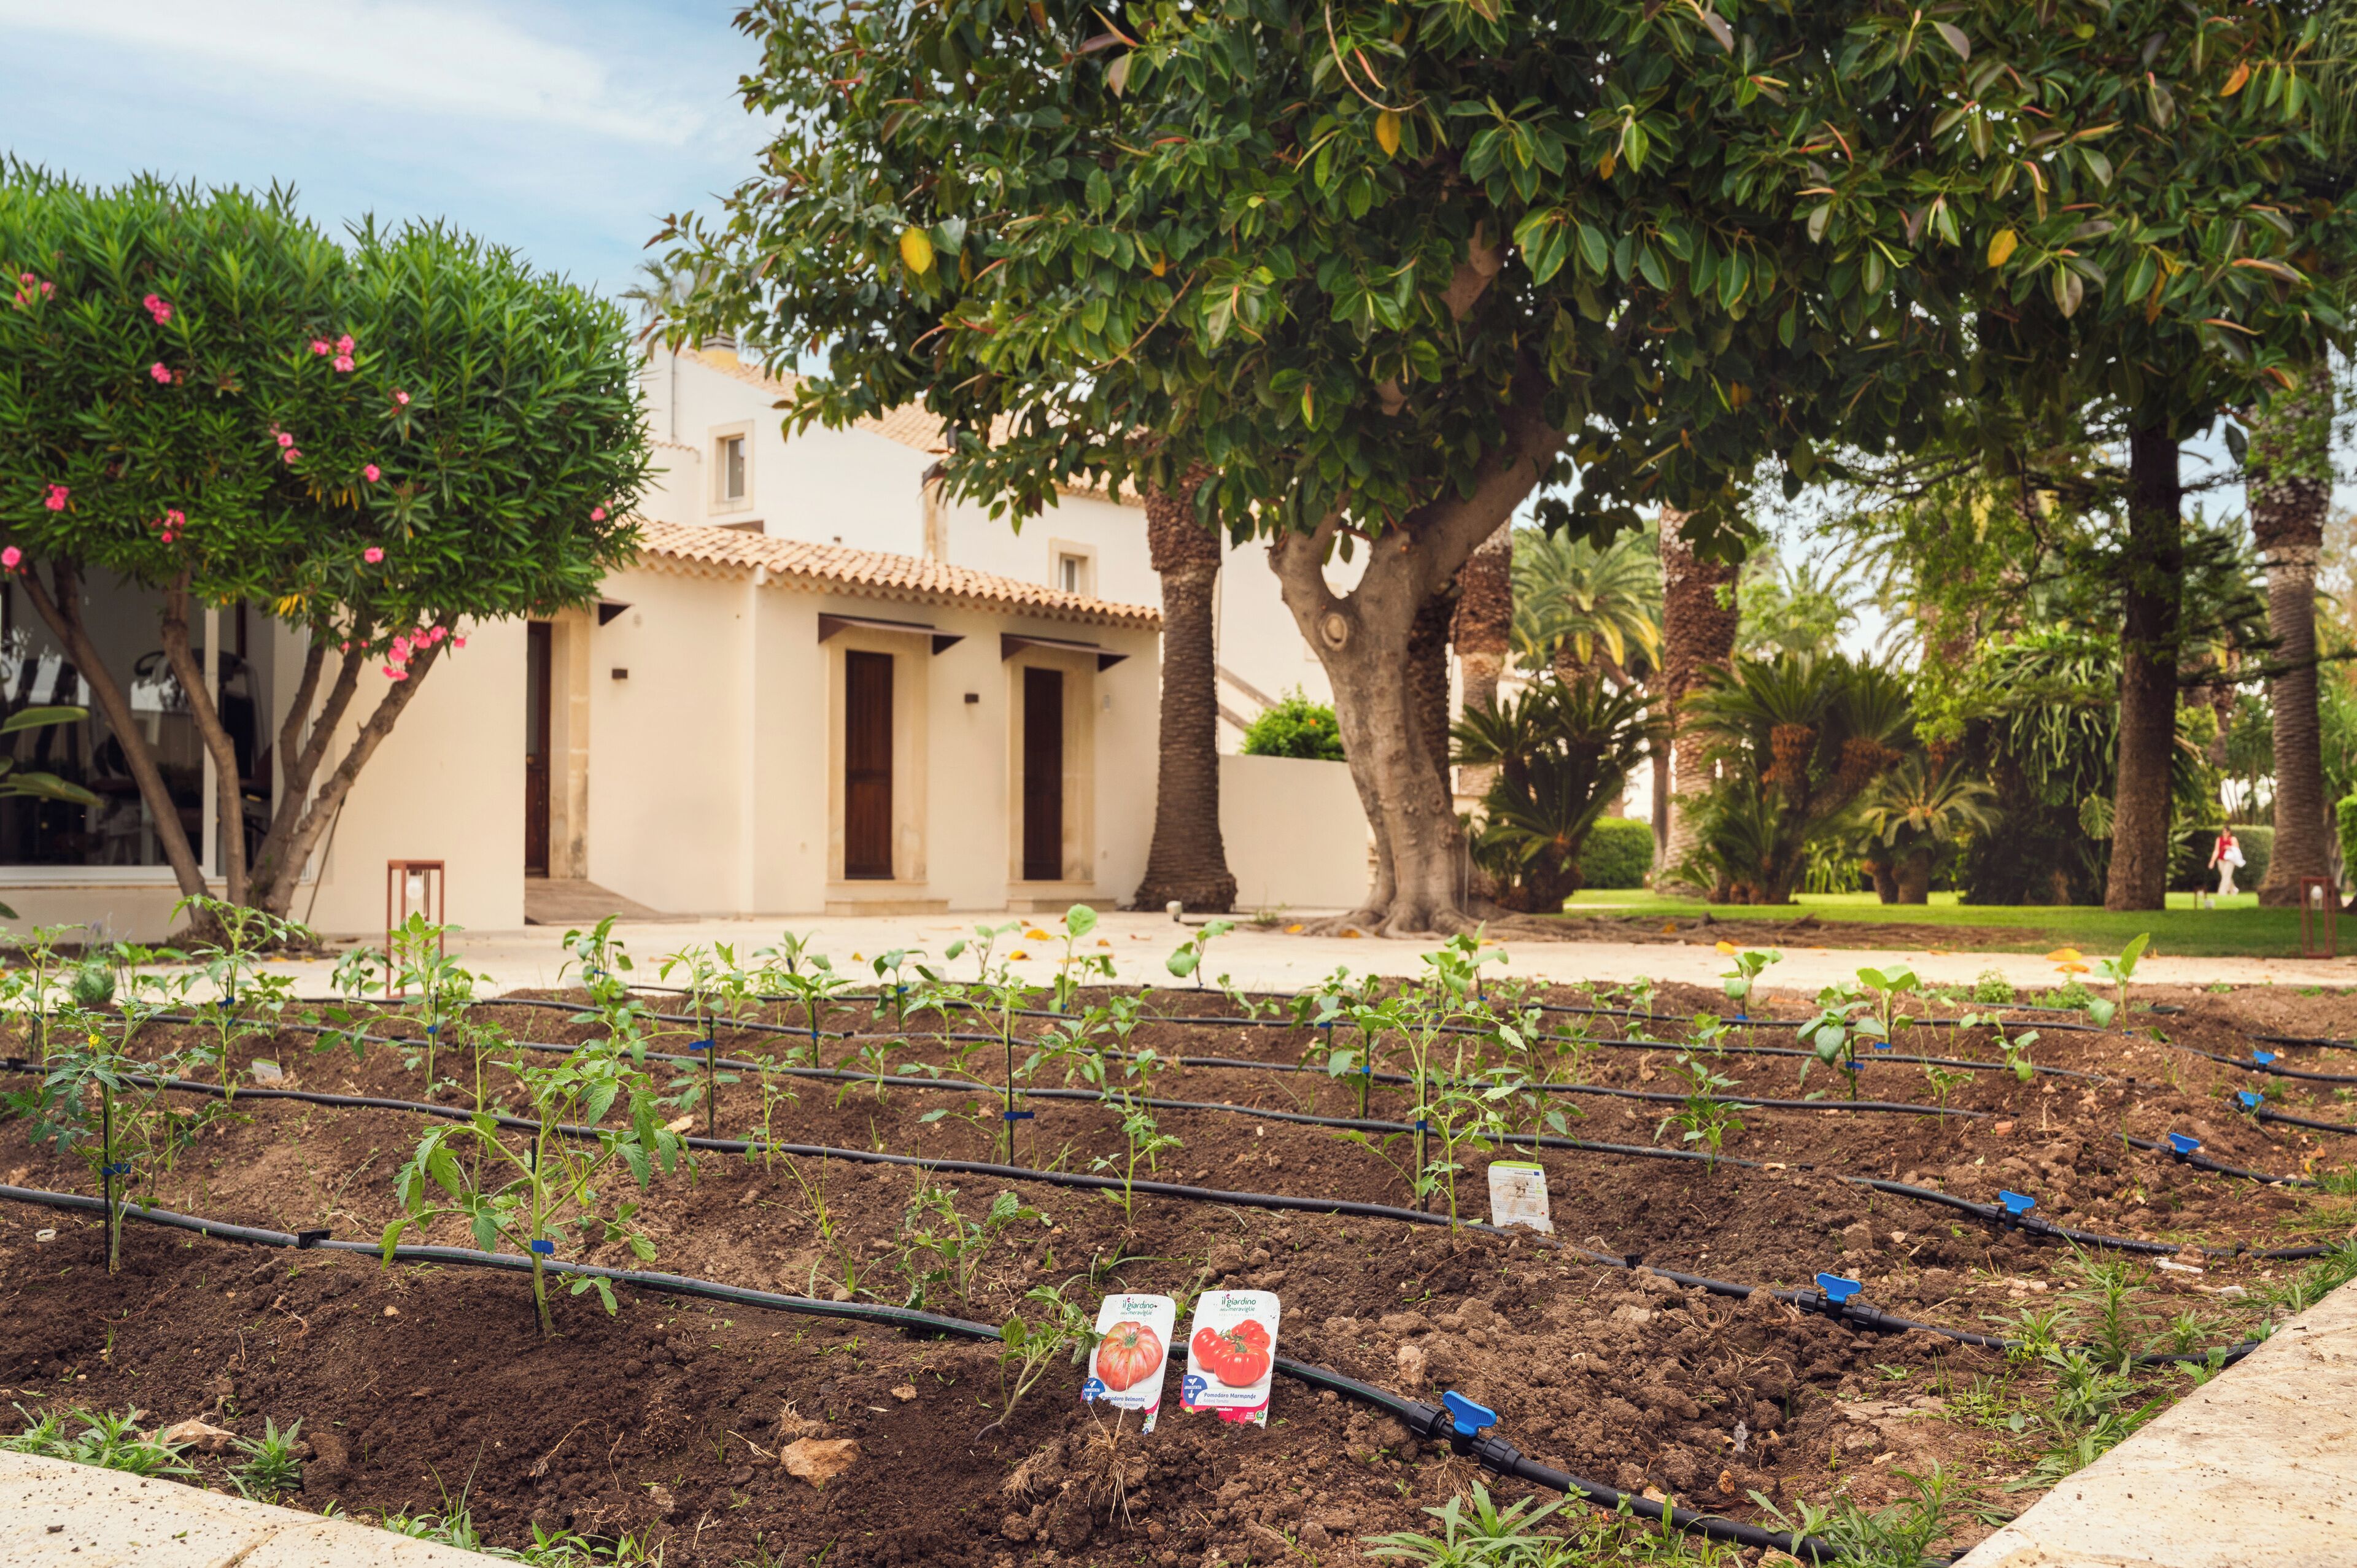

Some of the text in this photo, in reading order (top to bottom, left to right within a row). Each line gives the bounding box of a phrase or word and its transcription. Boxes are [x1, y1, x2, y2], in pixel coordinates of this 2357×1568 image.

[1123, 1299, 1154, 1311] il giardino
[1221, 1296, 1256, 1308] il giardino
